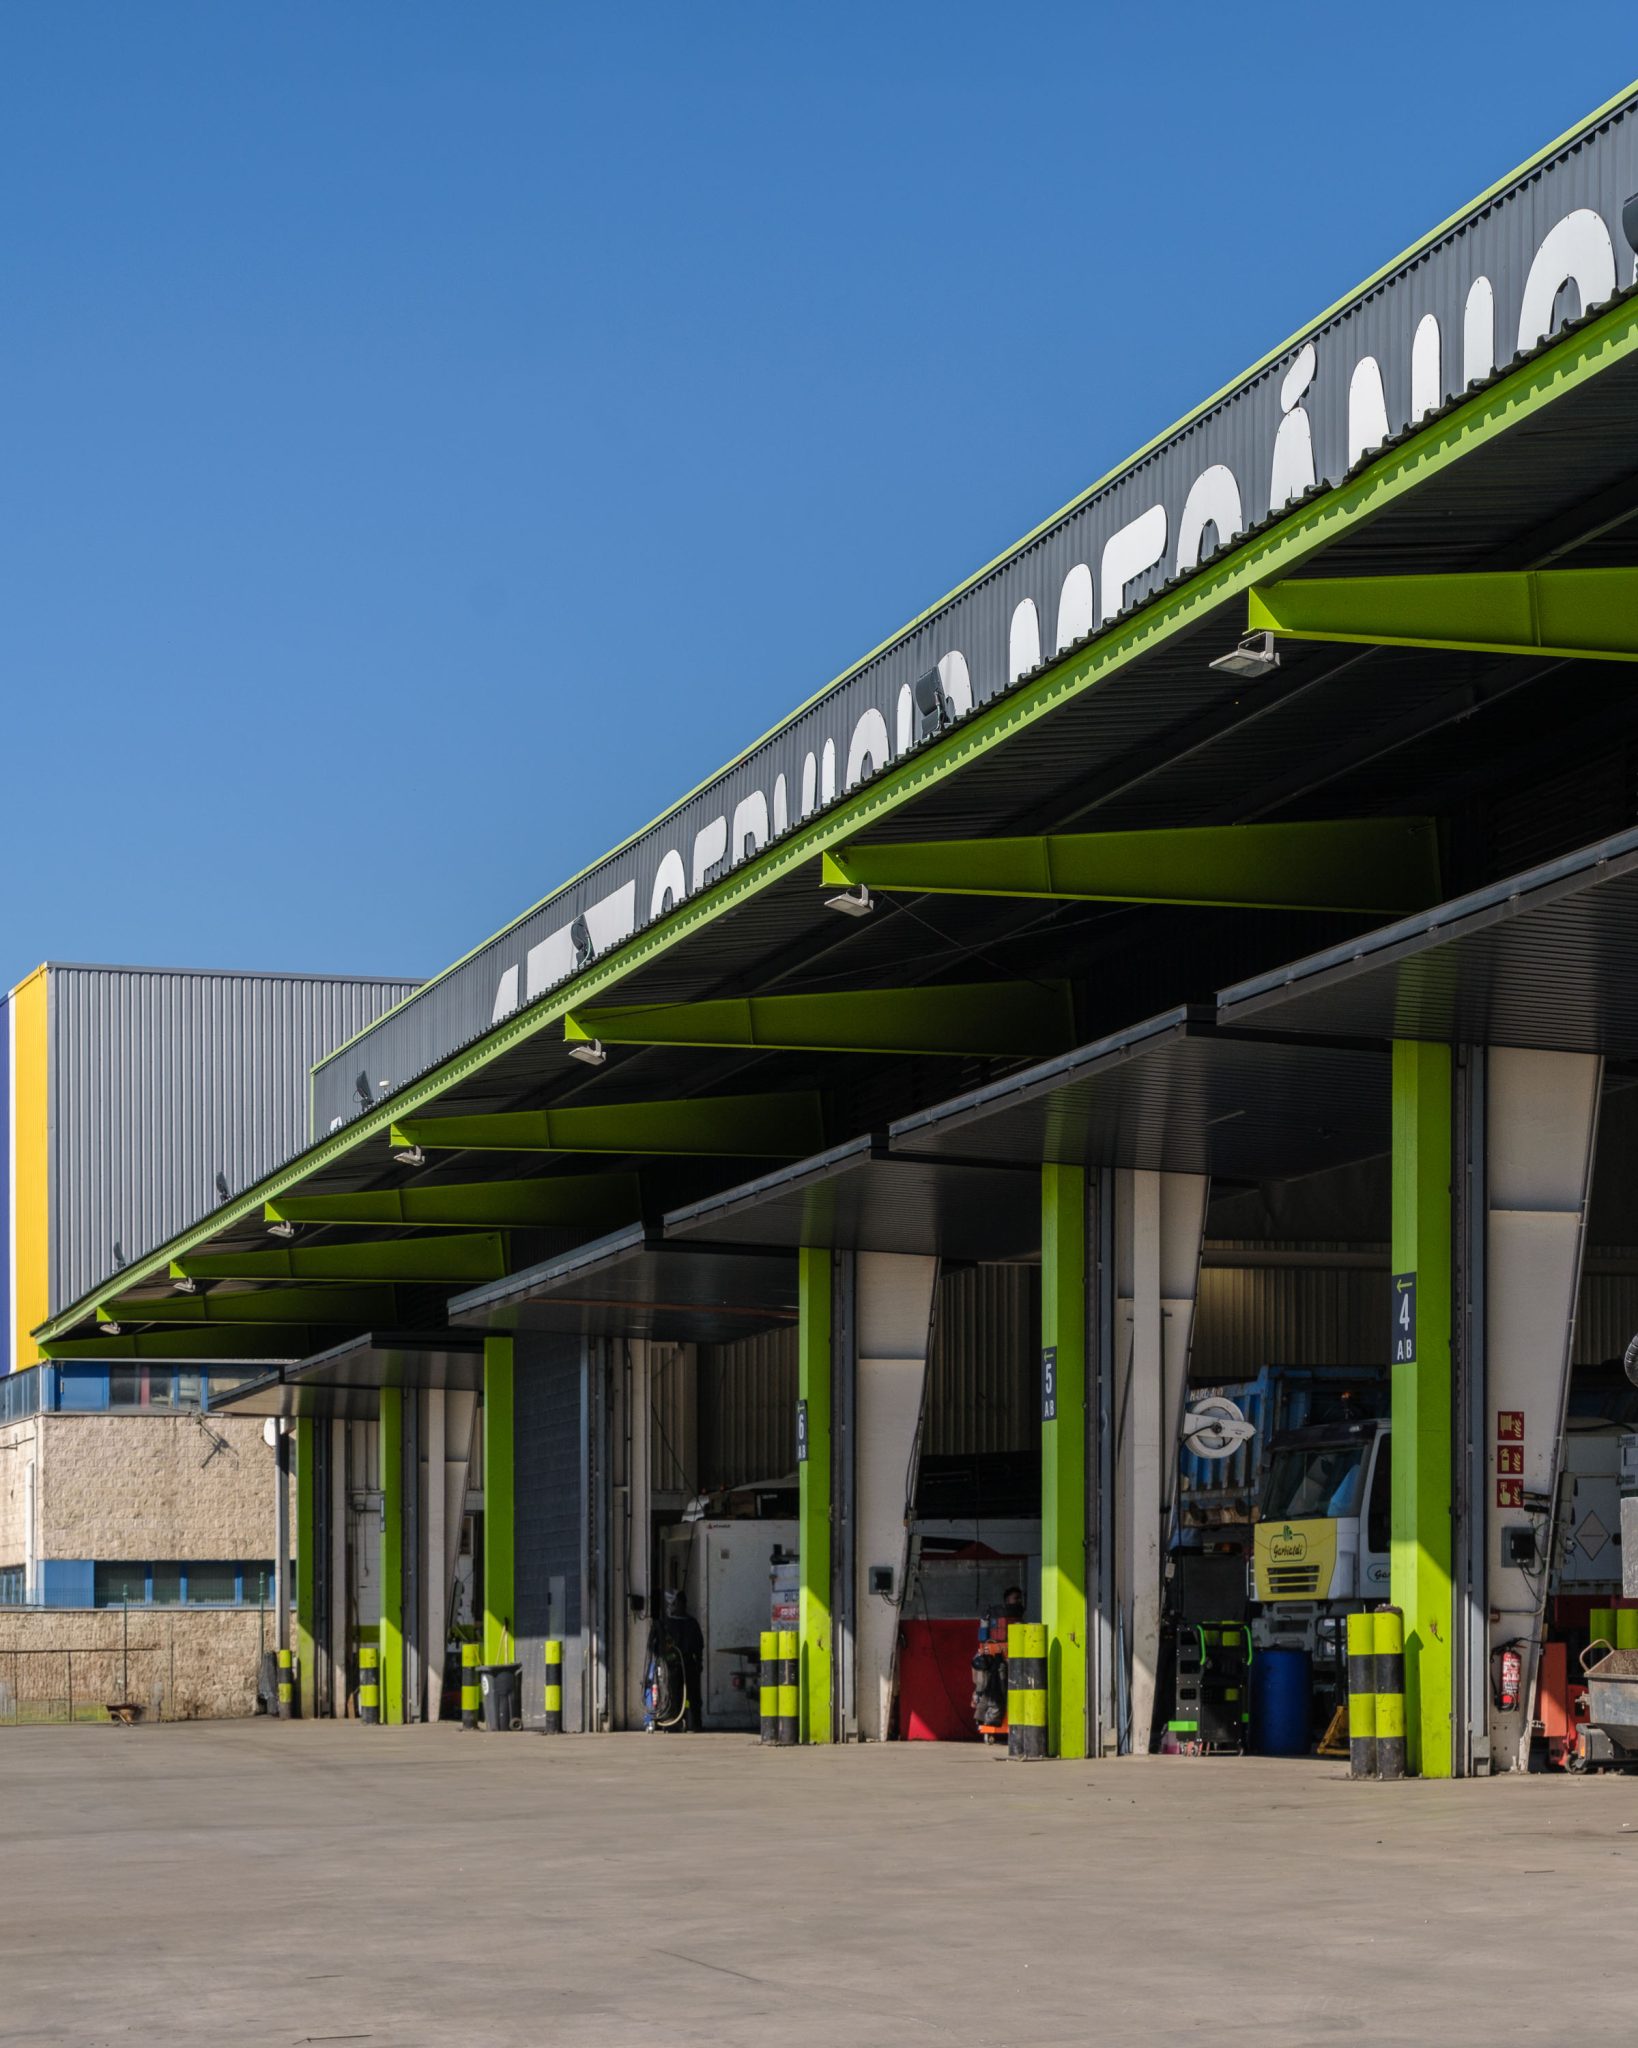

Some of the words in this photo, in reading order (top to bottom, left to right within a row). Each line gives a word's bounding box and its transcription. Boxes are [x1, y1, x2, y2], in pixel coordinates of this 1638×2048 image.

[1399, 1293, 1410, 1332] 4
[1045, 1363, 1052, 1394] 5
[798, 1413, 804, 1440] 6
[1273, 1542, 1303, 1559] Garbialdi
